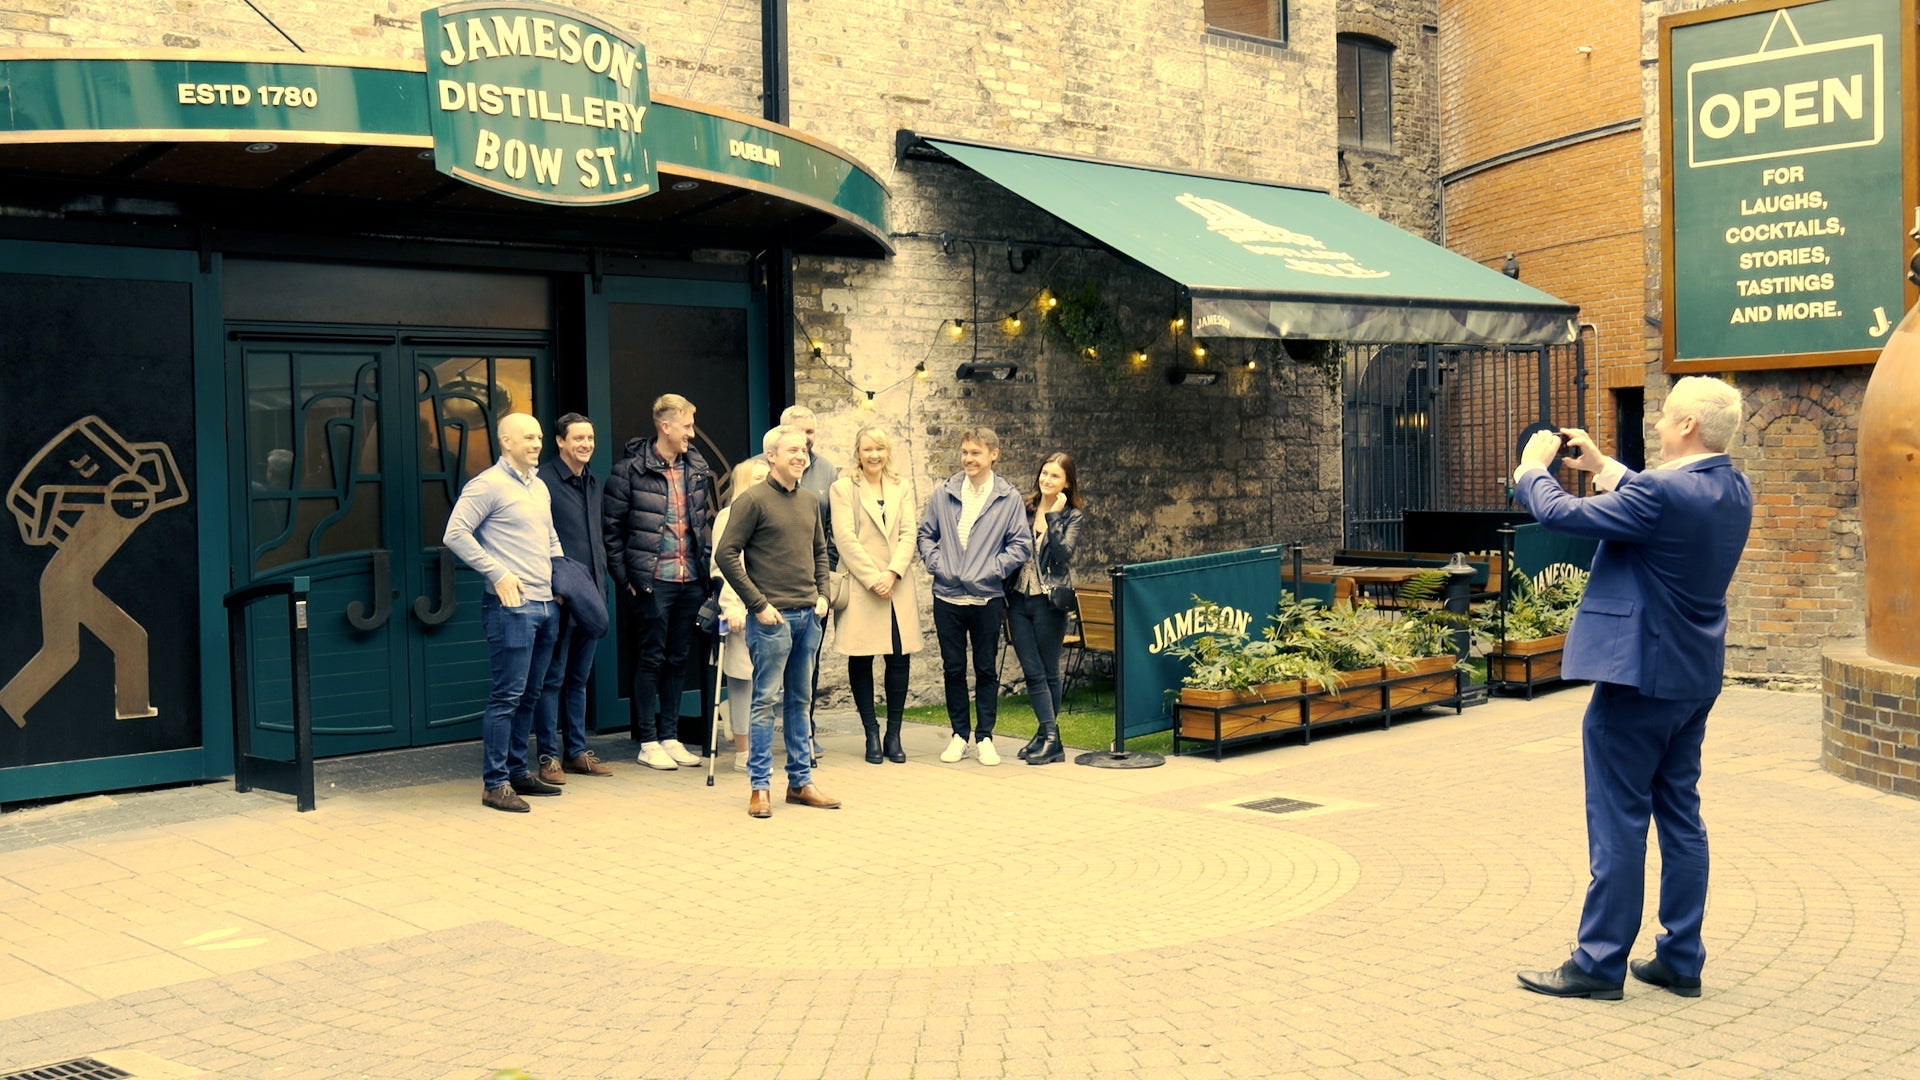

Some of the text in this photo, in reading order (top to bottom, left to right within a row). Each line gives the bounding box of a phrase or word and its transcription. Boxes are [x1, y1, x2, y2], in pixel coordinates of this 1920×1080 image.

[440, 15, 642, 88] JAMESON
[178, 83, 318, 108] ESTD 1780
[438, 79, 646, 133] DISTILLERY
[1699, 74, 1863, 139] OPEN
[475, 129, 632, 188] BOW ST.
[729, 139, 781, 168] DUBLIN
[1762, 166, 1804, 186] FOR
[1741, 191, 1828, 216] LAUGHS,
[1725, 217, 1846, 244] COCKTAILS,
[1739, 246, 1830, 270] STORIES,
[1737, 273, 1834, 297] TASTINGS
[1730, 300, 1842, 325] AND MORE.
